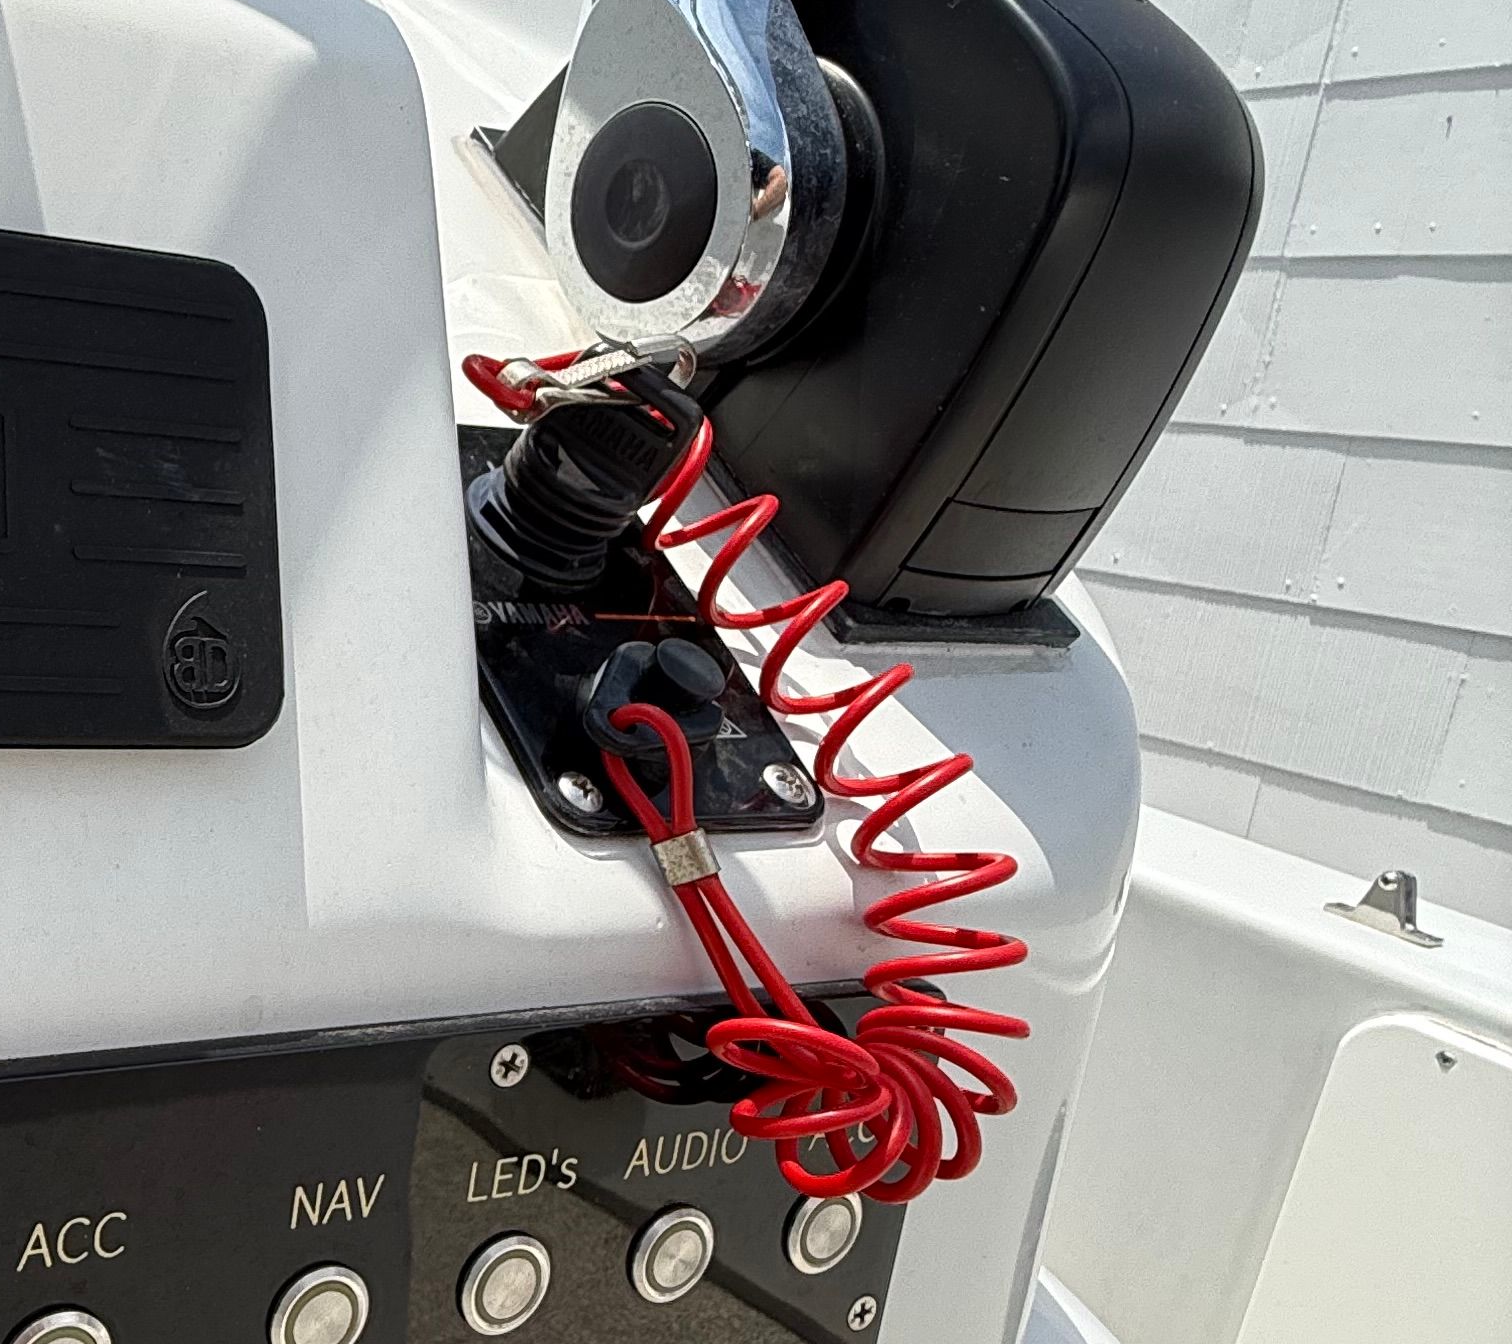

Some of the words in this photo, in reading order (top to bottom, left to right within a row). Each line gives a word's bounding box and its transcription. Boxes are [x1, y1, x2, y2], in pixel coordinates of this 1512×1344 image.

[488, 601, 590, 625] YAMAHA
[466, 1148, 579, 1203] LED's
[623, 1128, 749, 1180] AUDIO
[290, 1173, 386, 1229] NAV
[17, 1211, 128, 1272] ACC
